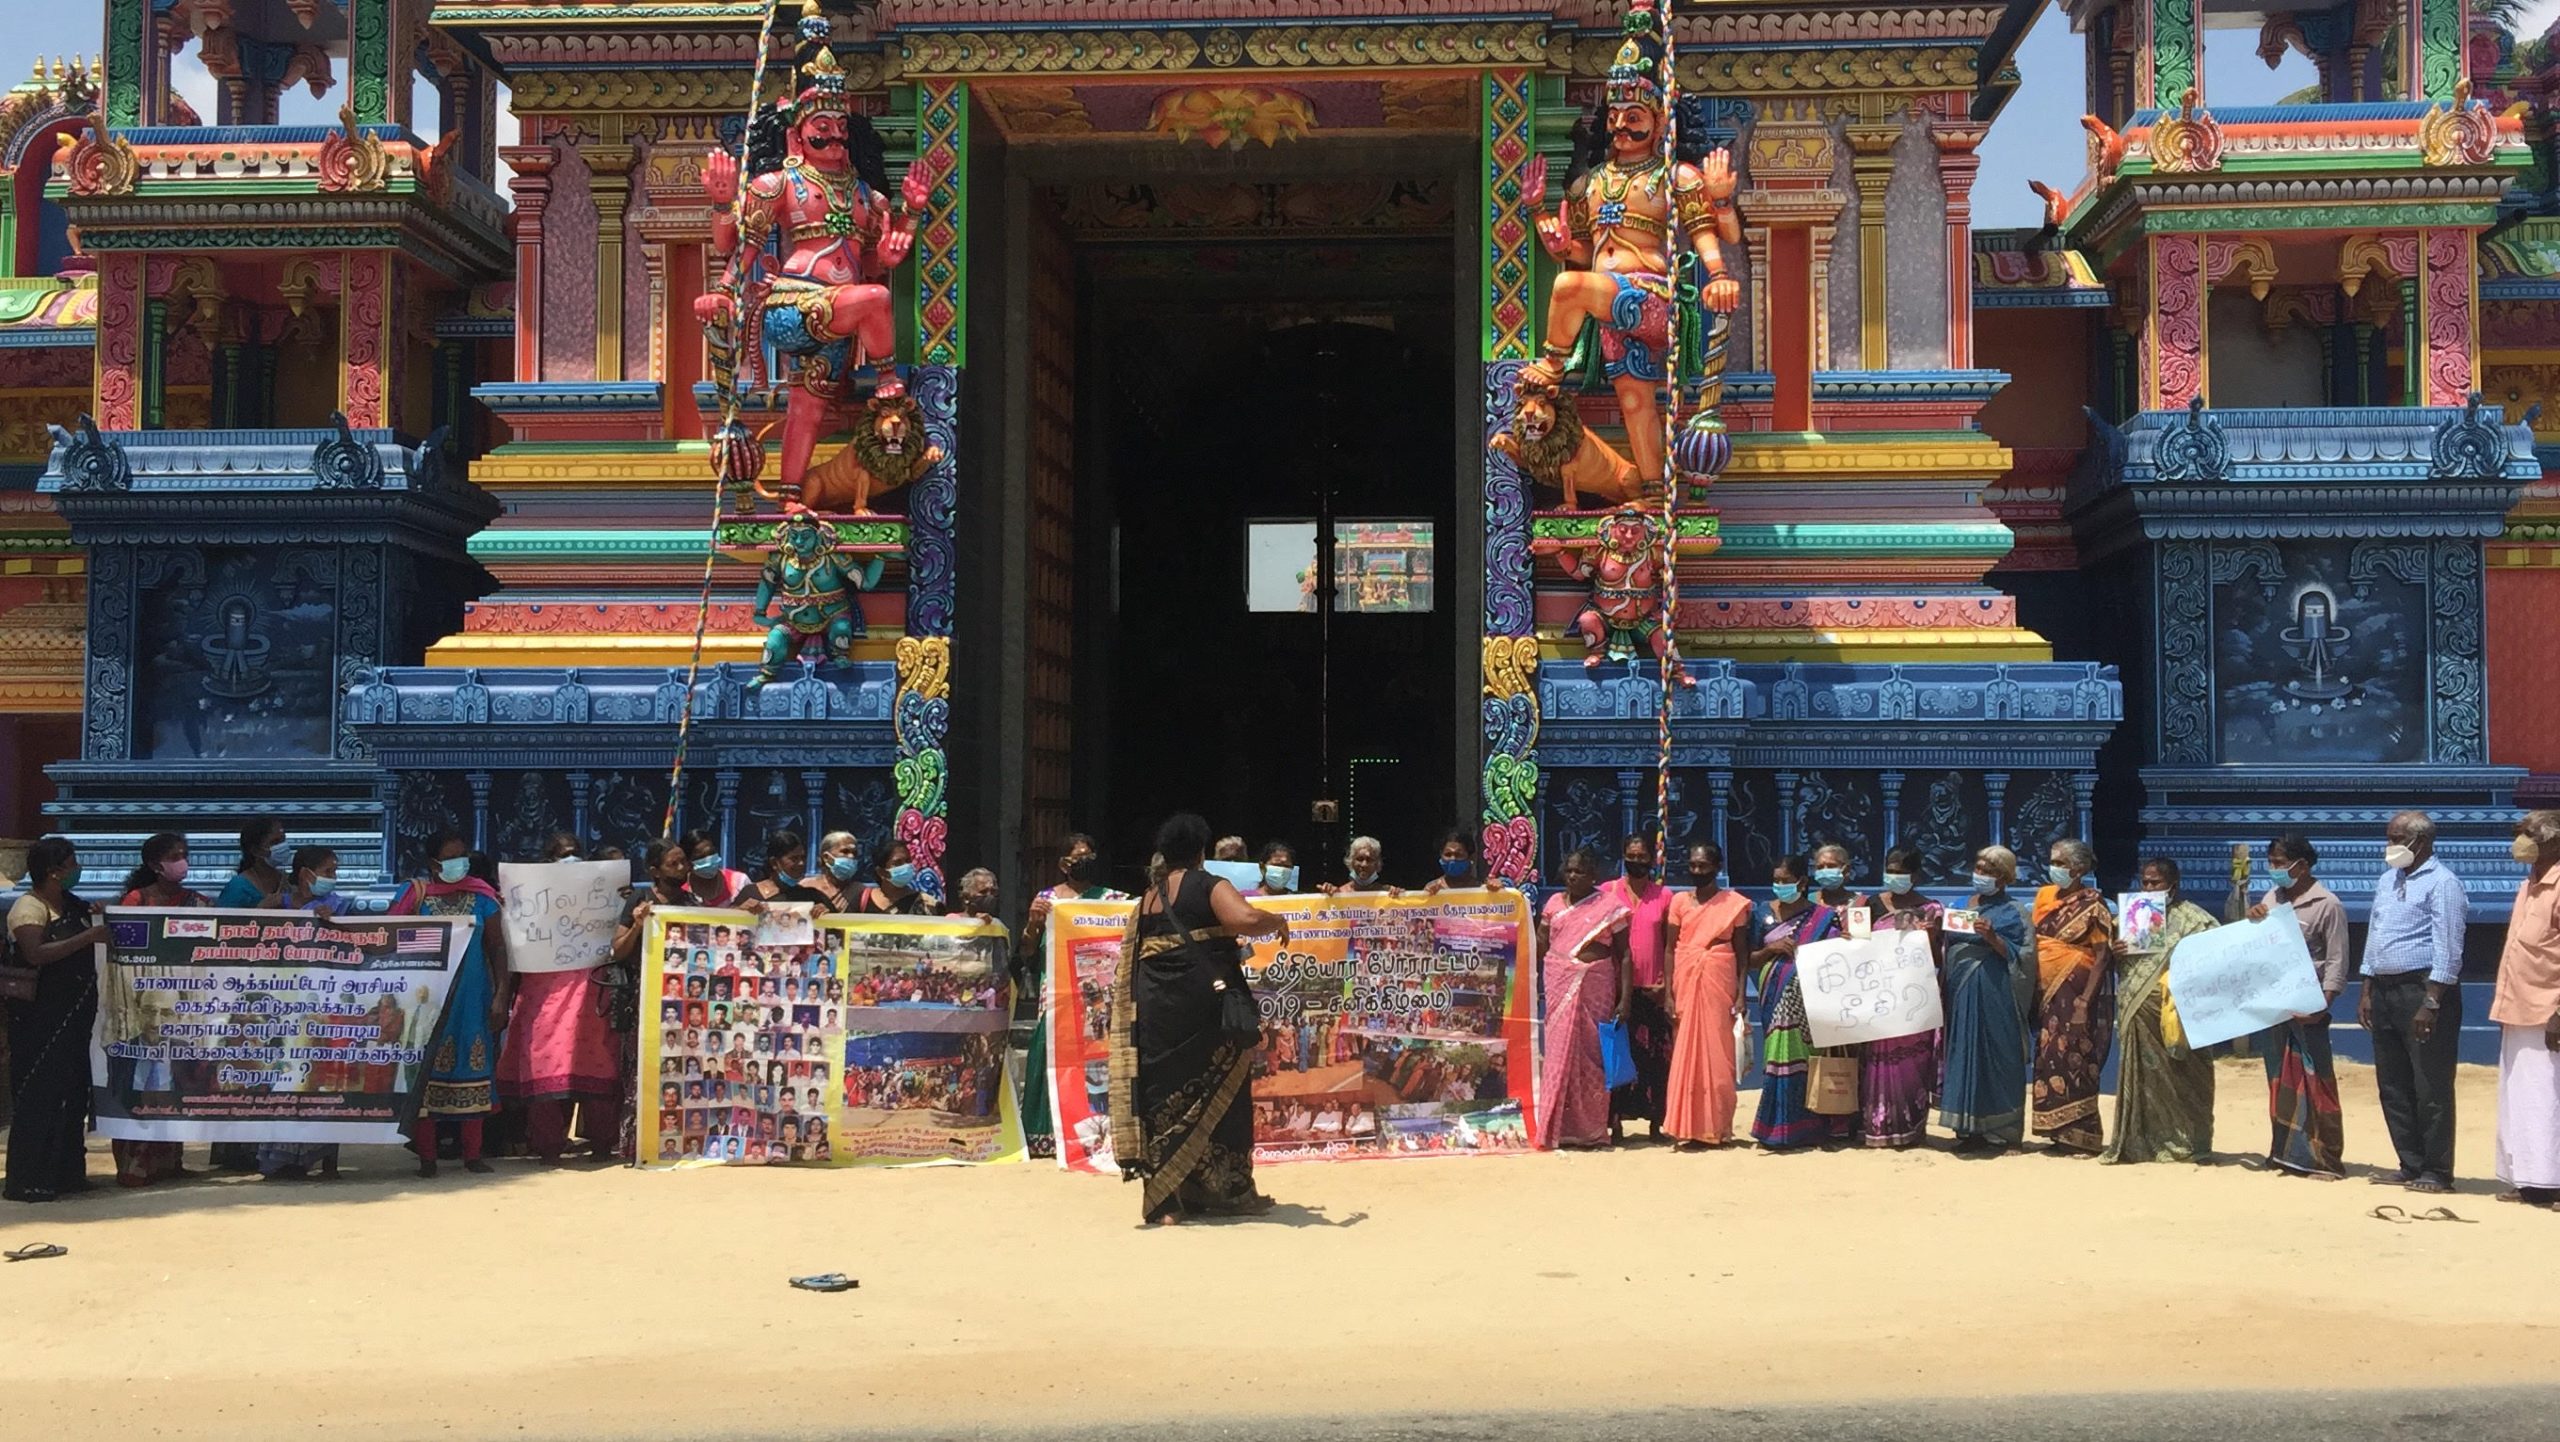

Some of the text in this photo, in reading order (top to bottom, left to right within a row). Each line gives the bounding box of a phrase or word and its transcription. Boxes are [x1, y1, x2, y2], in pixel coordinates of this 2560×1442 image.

[510, 884, 577, 921] கால
[218, 921, 258, 941] நாள்
[261, 921, 313, 943] தமிழர்
[314, 926, 389, 947] தலைநகர்
[191, 943, 364, 965] தாய்மாரின் போராட்டம்
[1367, 947, 1482, 980] போராட்டம்
[134, 973, 408, 994] காணாமல் ஆக்கப்பட்டோர் அரசியல்
[175, 996, 367, 1017] கைதிகள் விடுதலைக்காக
[1259, 997, 1300, 1018] 019
[160, 1018, 382, 1043] ஜனநாயக வழியில் போராடிய
